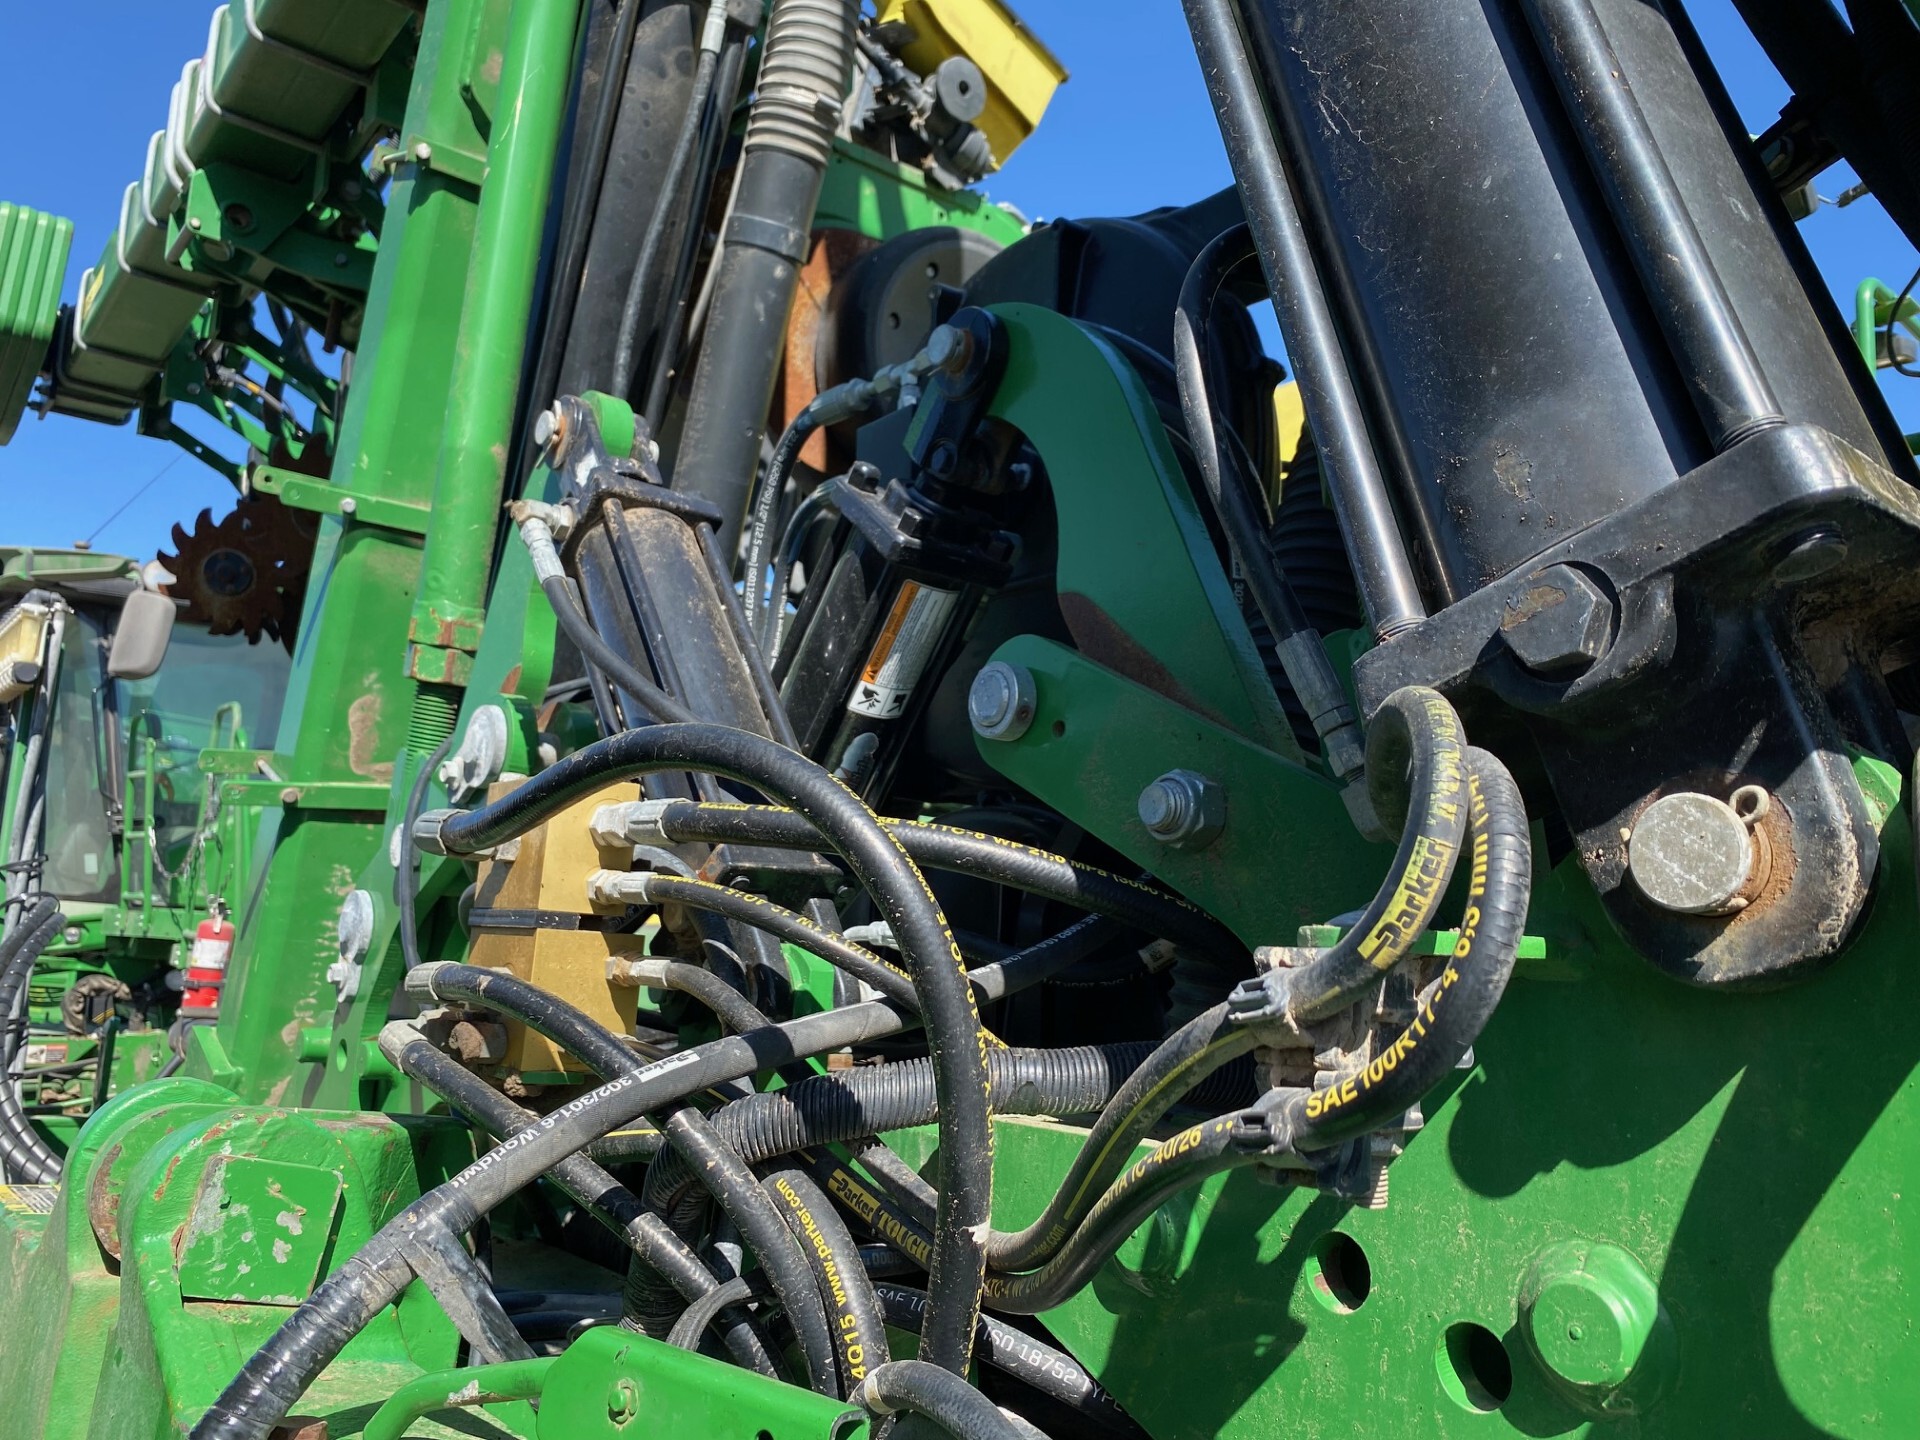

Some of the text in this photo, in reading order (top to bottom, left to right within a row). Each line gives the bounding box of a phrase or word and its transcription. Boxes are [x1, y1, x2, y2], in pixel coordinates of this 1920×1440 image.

[828, 772, 936, 903] www.parker.com
[991, 836, 1024, 850] WP
[1366, 840, 1447, 962] Parker
[1306, 1076, 1359, 1119] SAE
[1361, 968, 1459, 1090] 100R17-4
[1455, 905, 1481, 958] 6,3
[1471, 841, 1489, 896] mm
[542, 1075, 632, 1130] 302/301-6
[829, 1177, 874, 1219] Parker
[879, 1210, 932, 1264] TOUGH
[775, 1178, 866, 1380] 4Q15 www.parker.com
[1019, 1343, 1078, 1385] 18752
